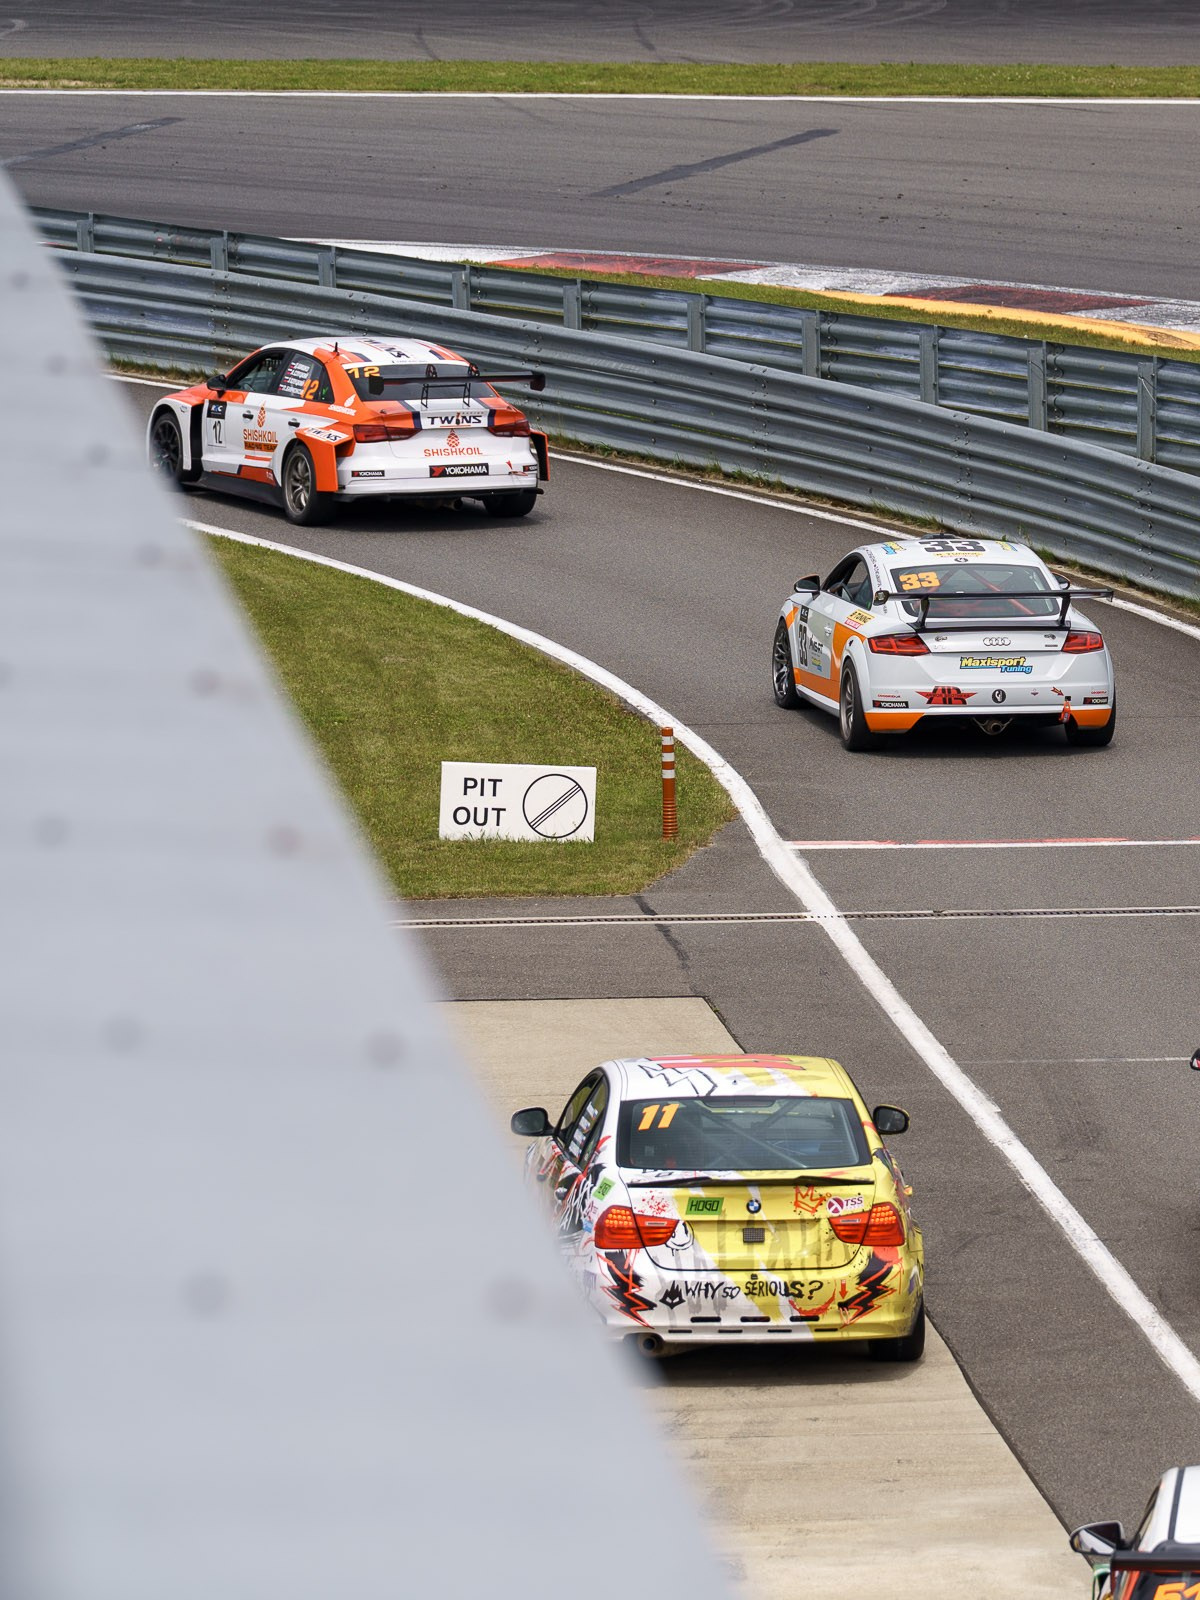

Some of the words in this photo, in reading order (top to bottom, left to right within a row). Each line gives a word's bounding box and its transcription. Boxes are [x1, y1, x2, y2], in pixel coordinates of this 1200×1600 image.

[347, 366, 380, 379] 12
[301, 379, 319, 400] 12
[213, 420, 223, 444] 12
[243, 429, 278, 443] SHISHKOIL
[423, 447, 483, 457] SHISHKOIL
[445, 465, 488, 476] YOKOHAMA
[919, 540, 986, 552] 33
[899, 571, 940, 591] 33
[960, 656, 1027, 669] Maxisport
[1000, 665, 1034, 674] Tuning
[463, 777, 503, 797] PIT
[452, 806, 506, 827] OUT
[637, 1103, 679, 1131] 11
[689, 1199, 719, 1212] HOGO
[845, 1197, 863, 1206] TSS
[685, 1281, 724, 1299] WHY
[744, 1280, 824, 1300] SERIOUS?
